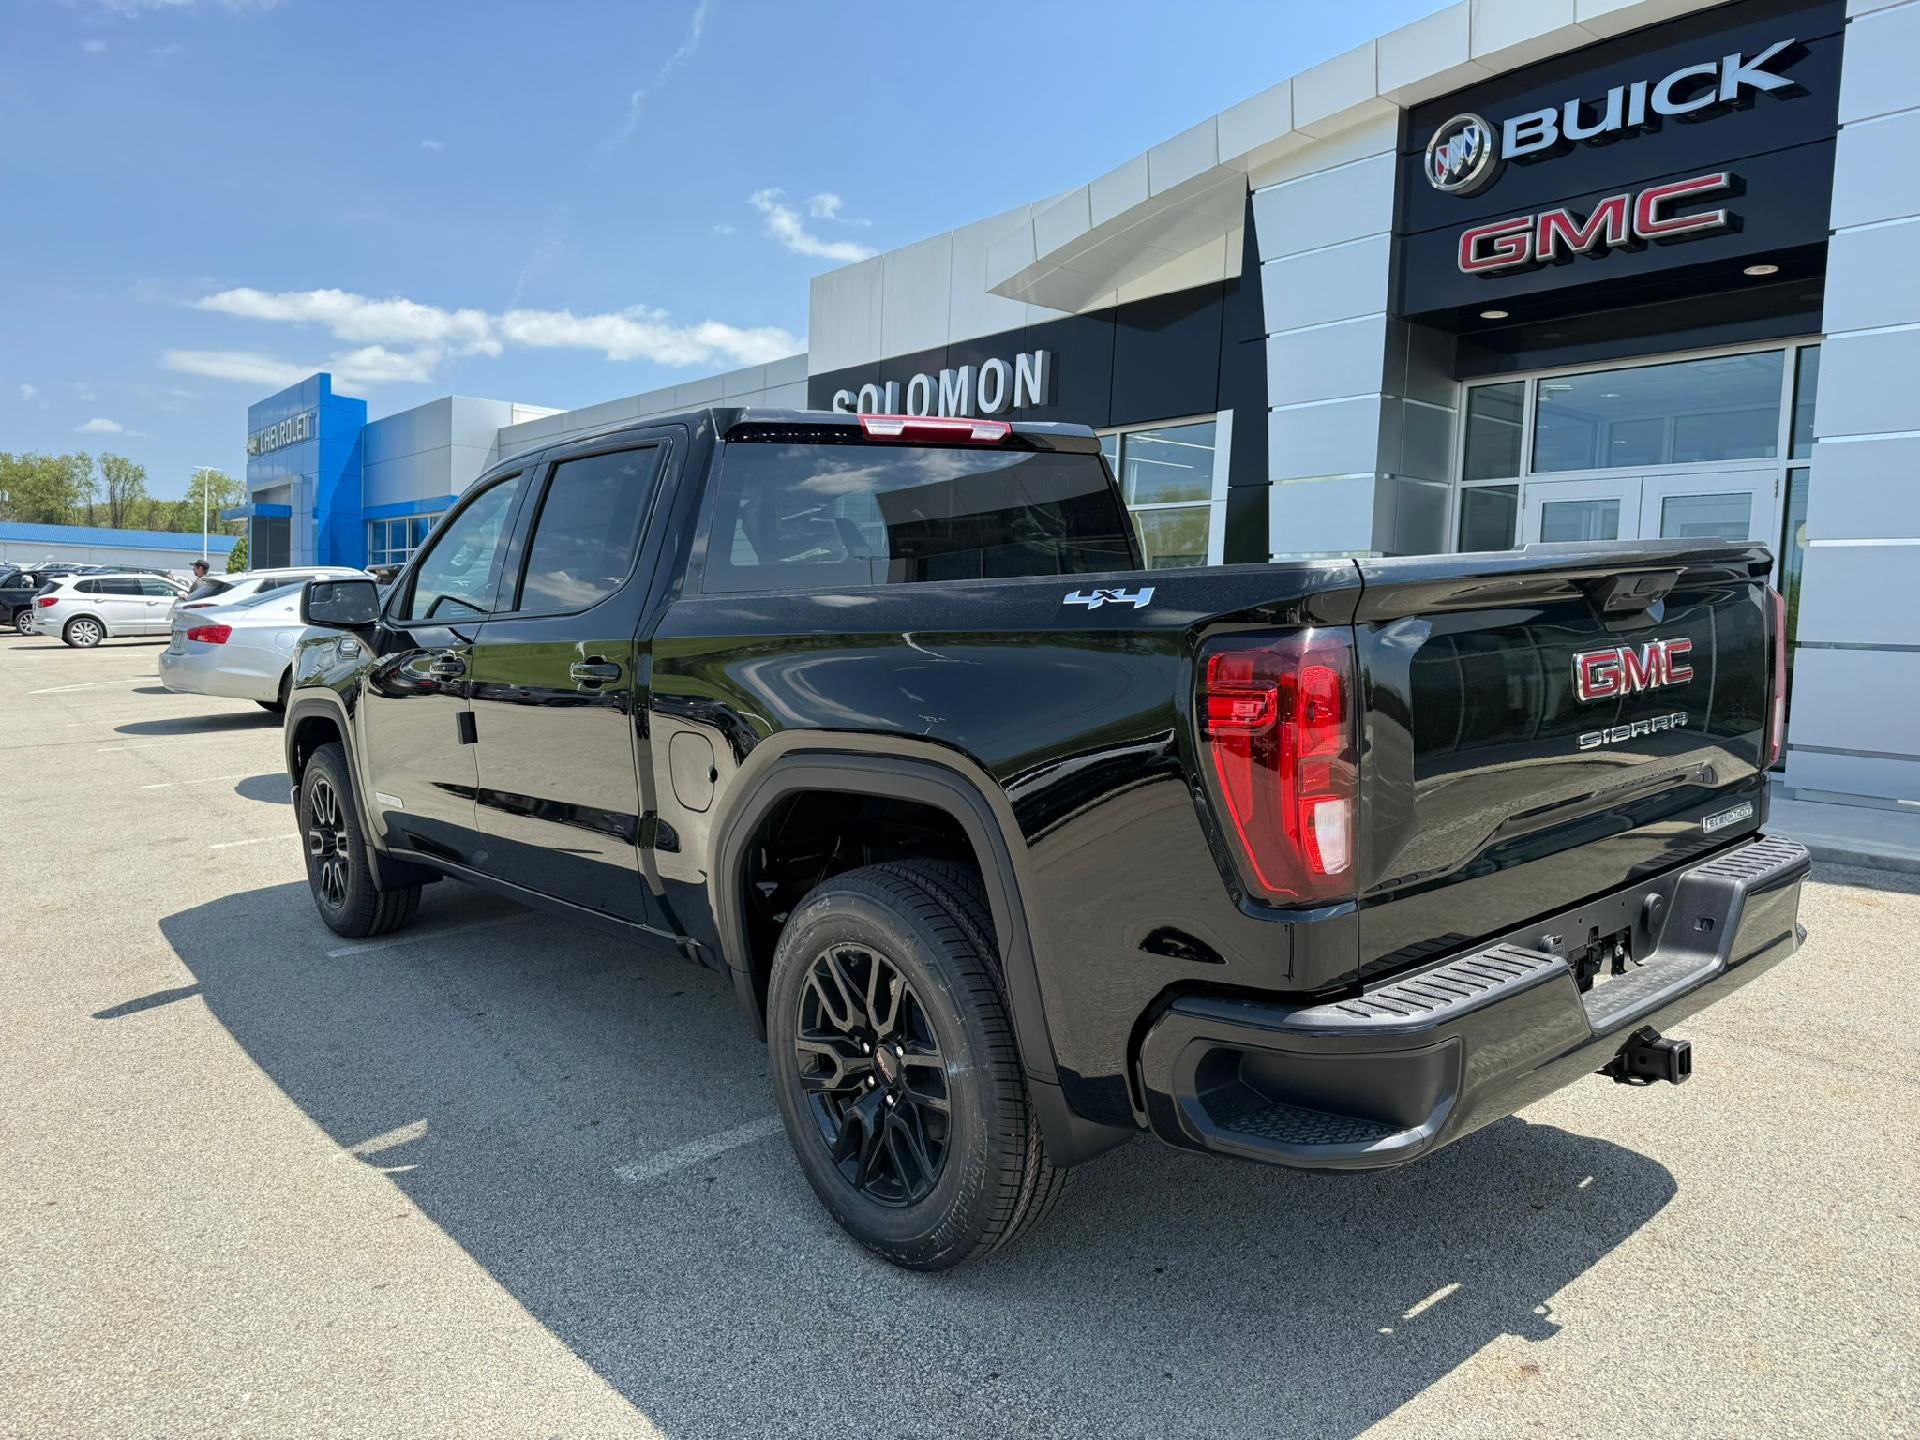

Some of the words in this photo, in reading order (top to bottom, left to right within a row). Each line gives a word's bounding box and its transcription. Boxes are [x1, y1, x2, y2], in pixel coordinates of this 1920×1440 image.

[1501, 37, 1796, 160] BUICK
[1457, 171, 1732, 274] GMC
[260, 412, 311, 454] CHEVROLET
[1573, 637, 1694, 703] GMC
[1577, 711, 1689, 750] SIERRA
